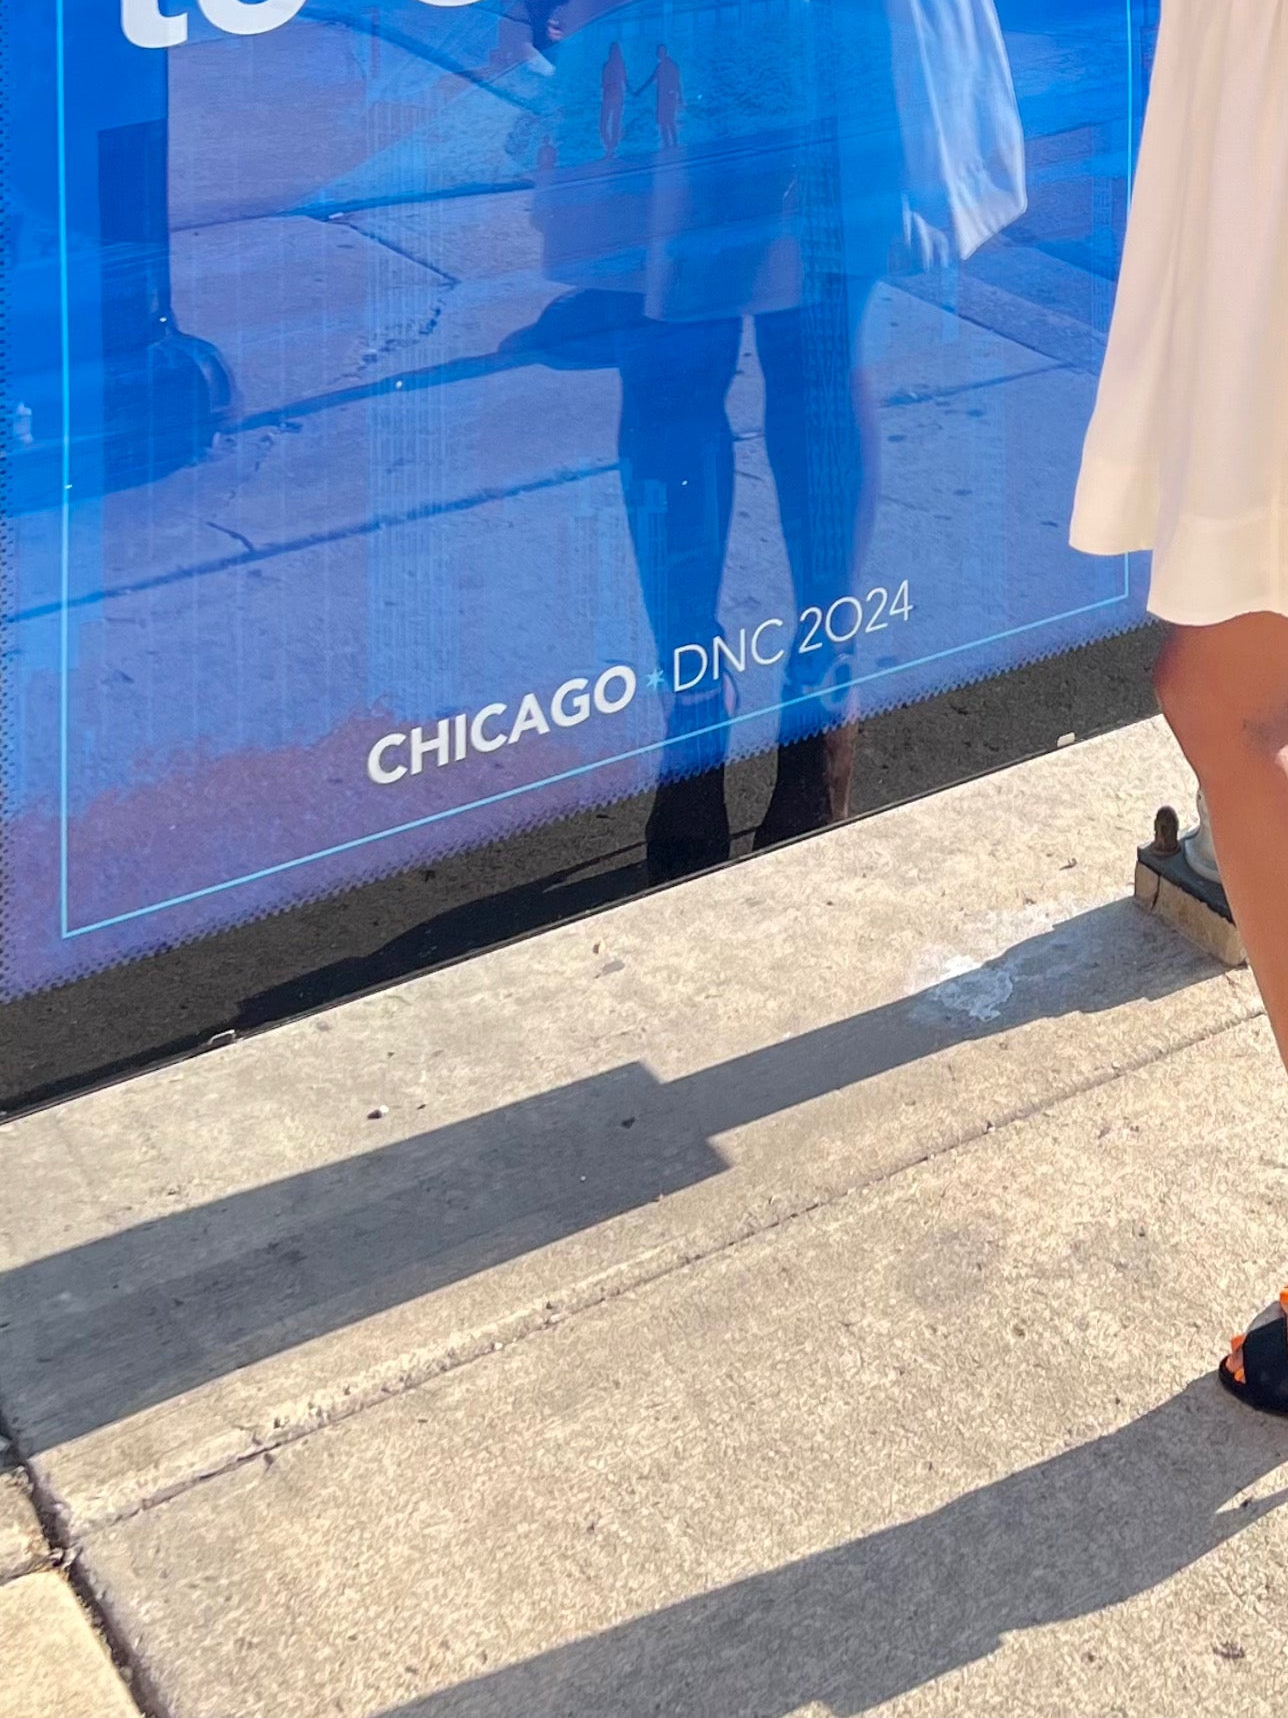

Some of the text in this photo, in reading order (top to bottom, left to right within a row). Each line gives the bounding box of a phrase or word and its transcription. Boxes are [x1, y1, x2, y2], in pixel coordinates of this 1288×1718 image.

[366, 579, 914, 785] CHICAGO DNC 2024
